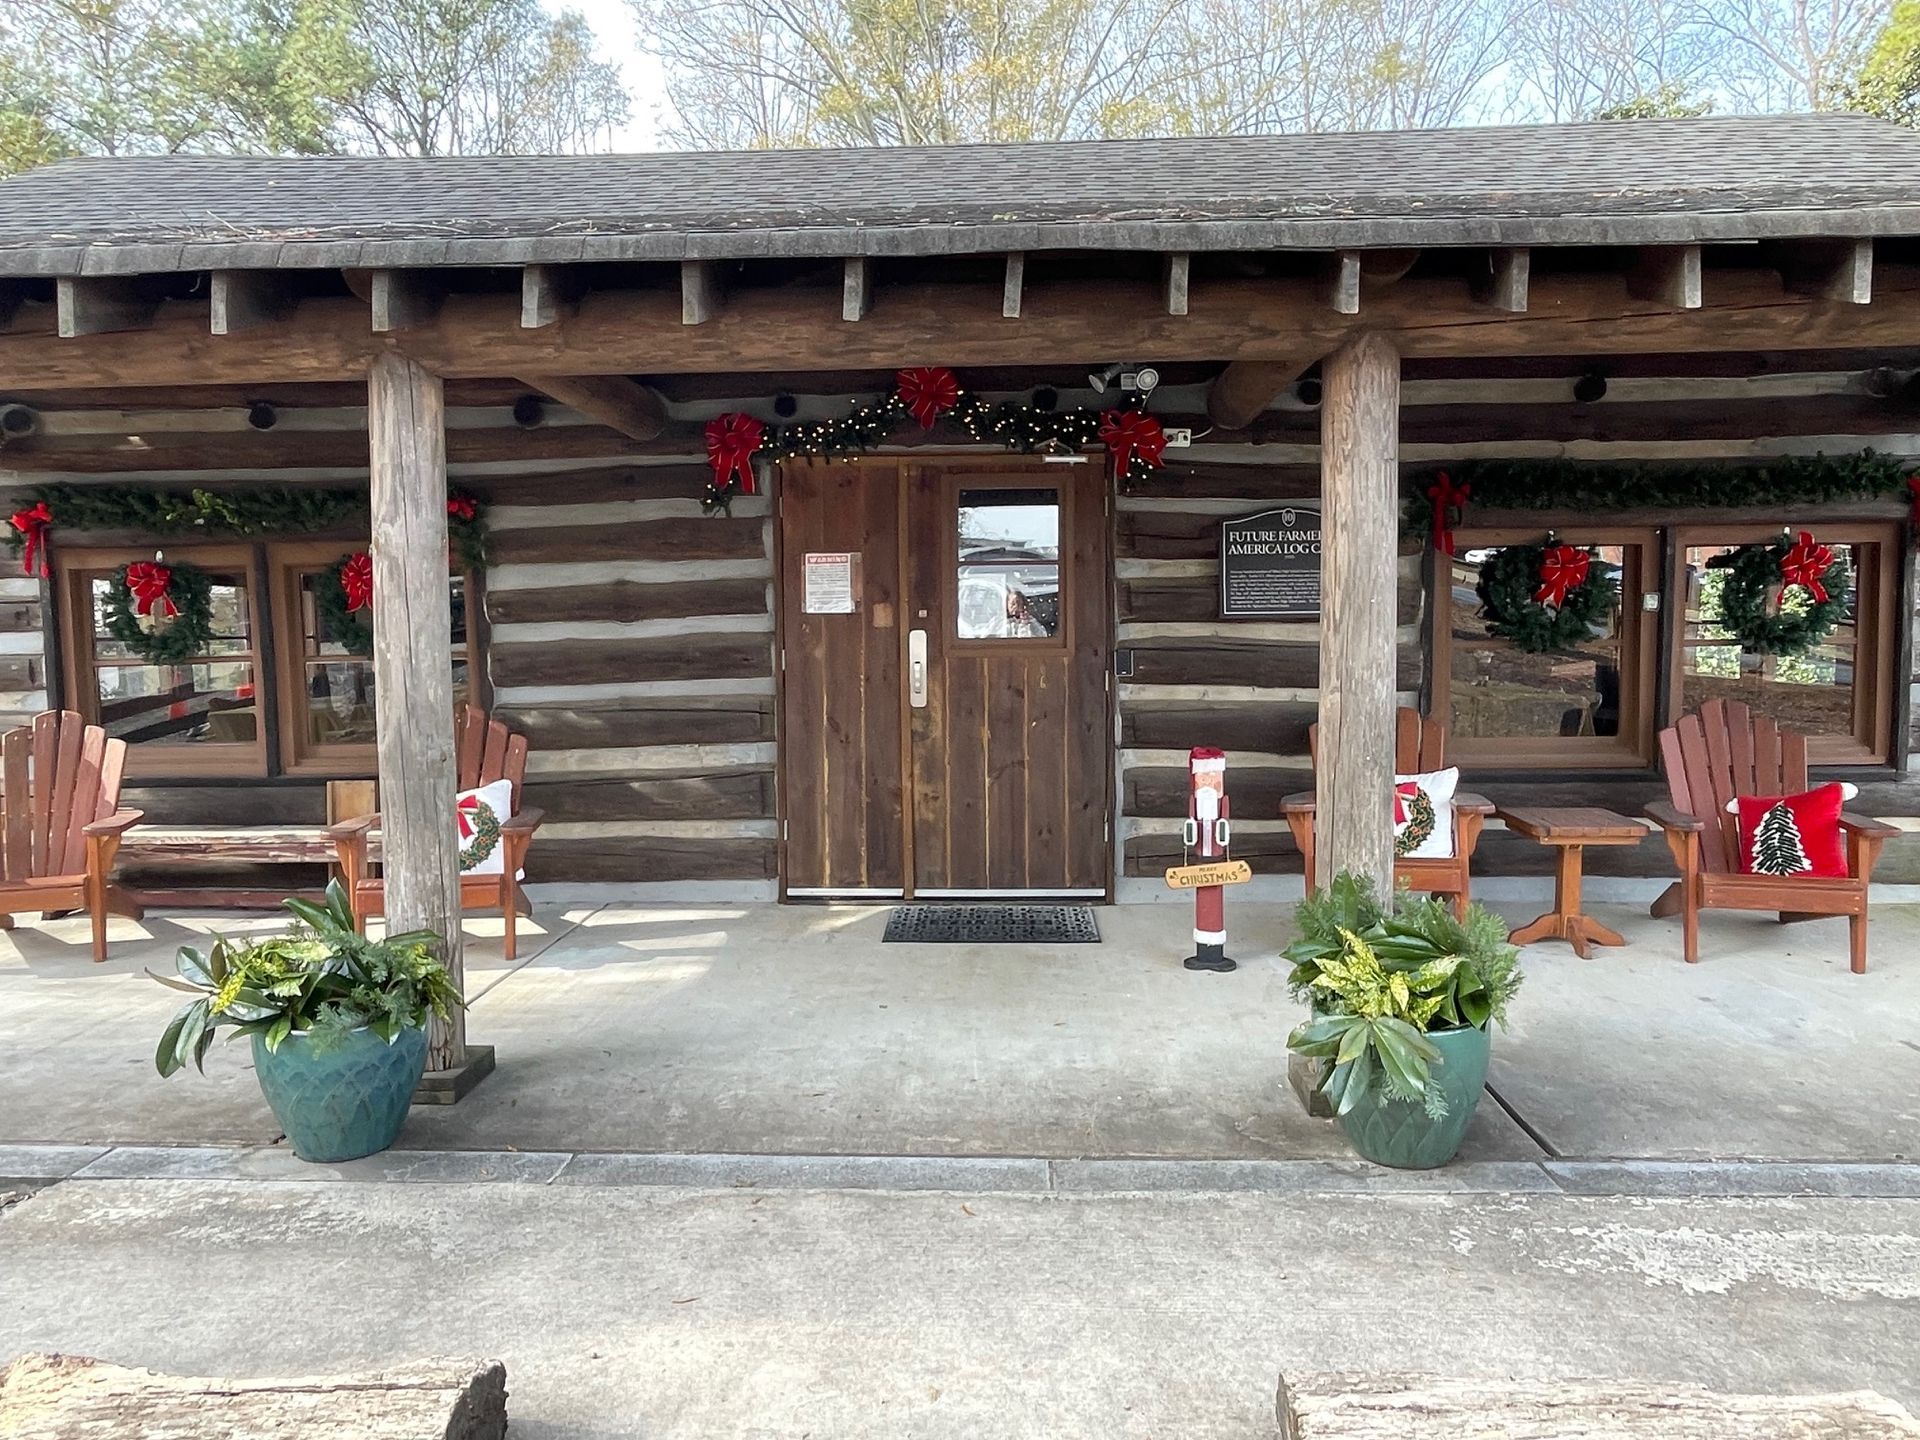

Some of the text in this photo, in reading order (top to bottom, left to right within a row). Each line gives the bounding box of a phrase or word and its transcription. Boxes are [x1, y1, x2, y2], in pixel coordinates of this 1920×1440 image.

[1284, 512, 1293, 522] 10
[1229, 531, 1277, 542] FUTURE
[1228, 543, 1282, 555] AMERICA
[1284, 543, 1310, 555] LOG
[1180, 871, 1238, 885] CHRISTMAS
